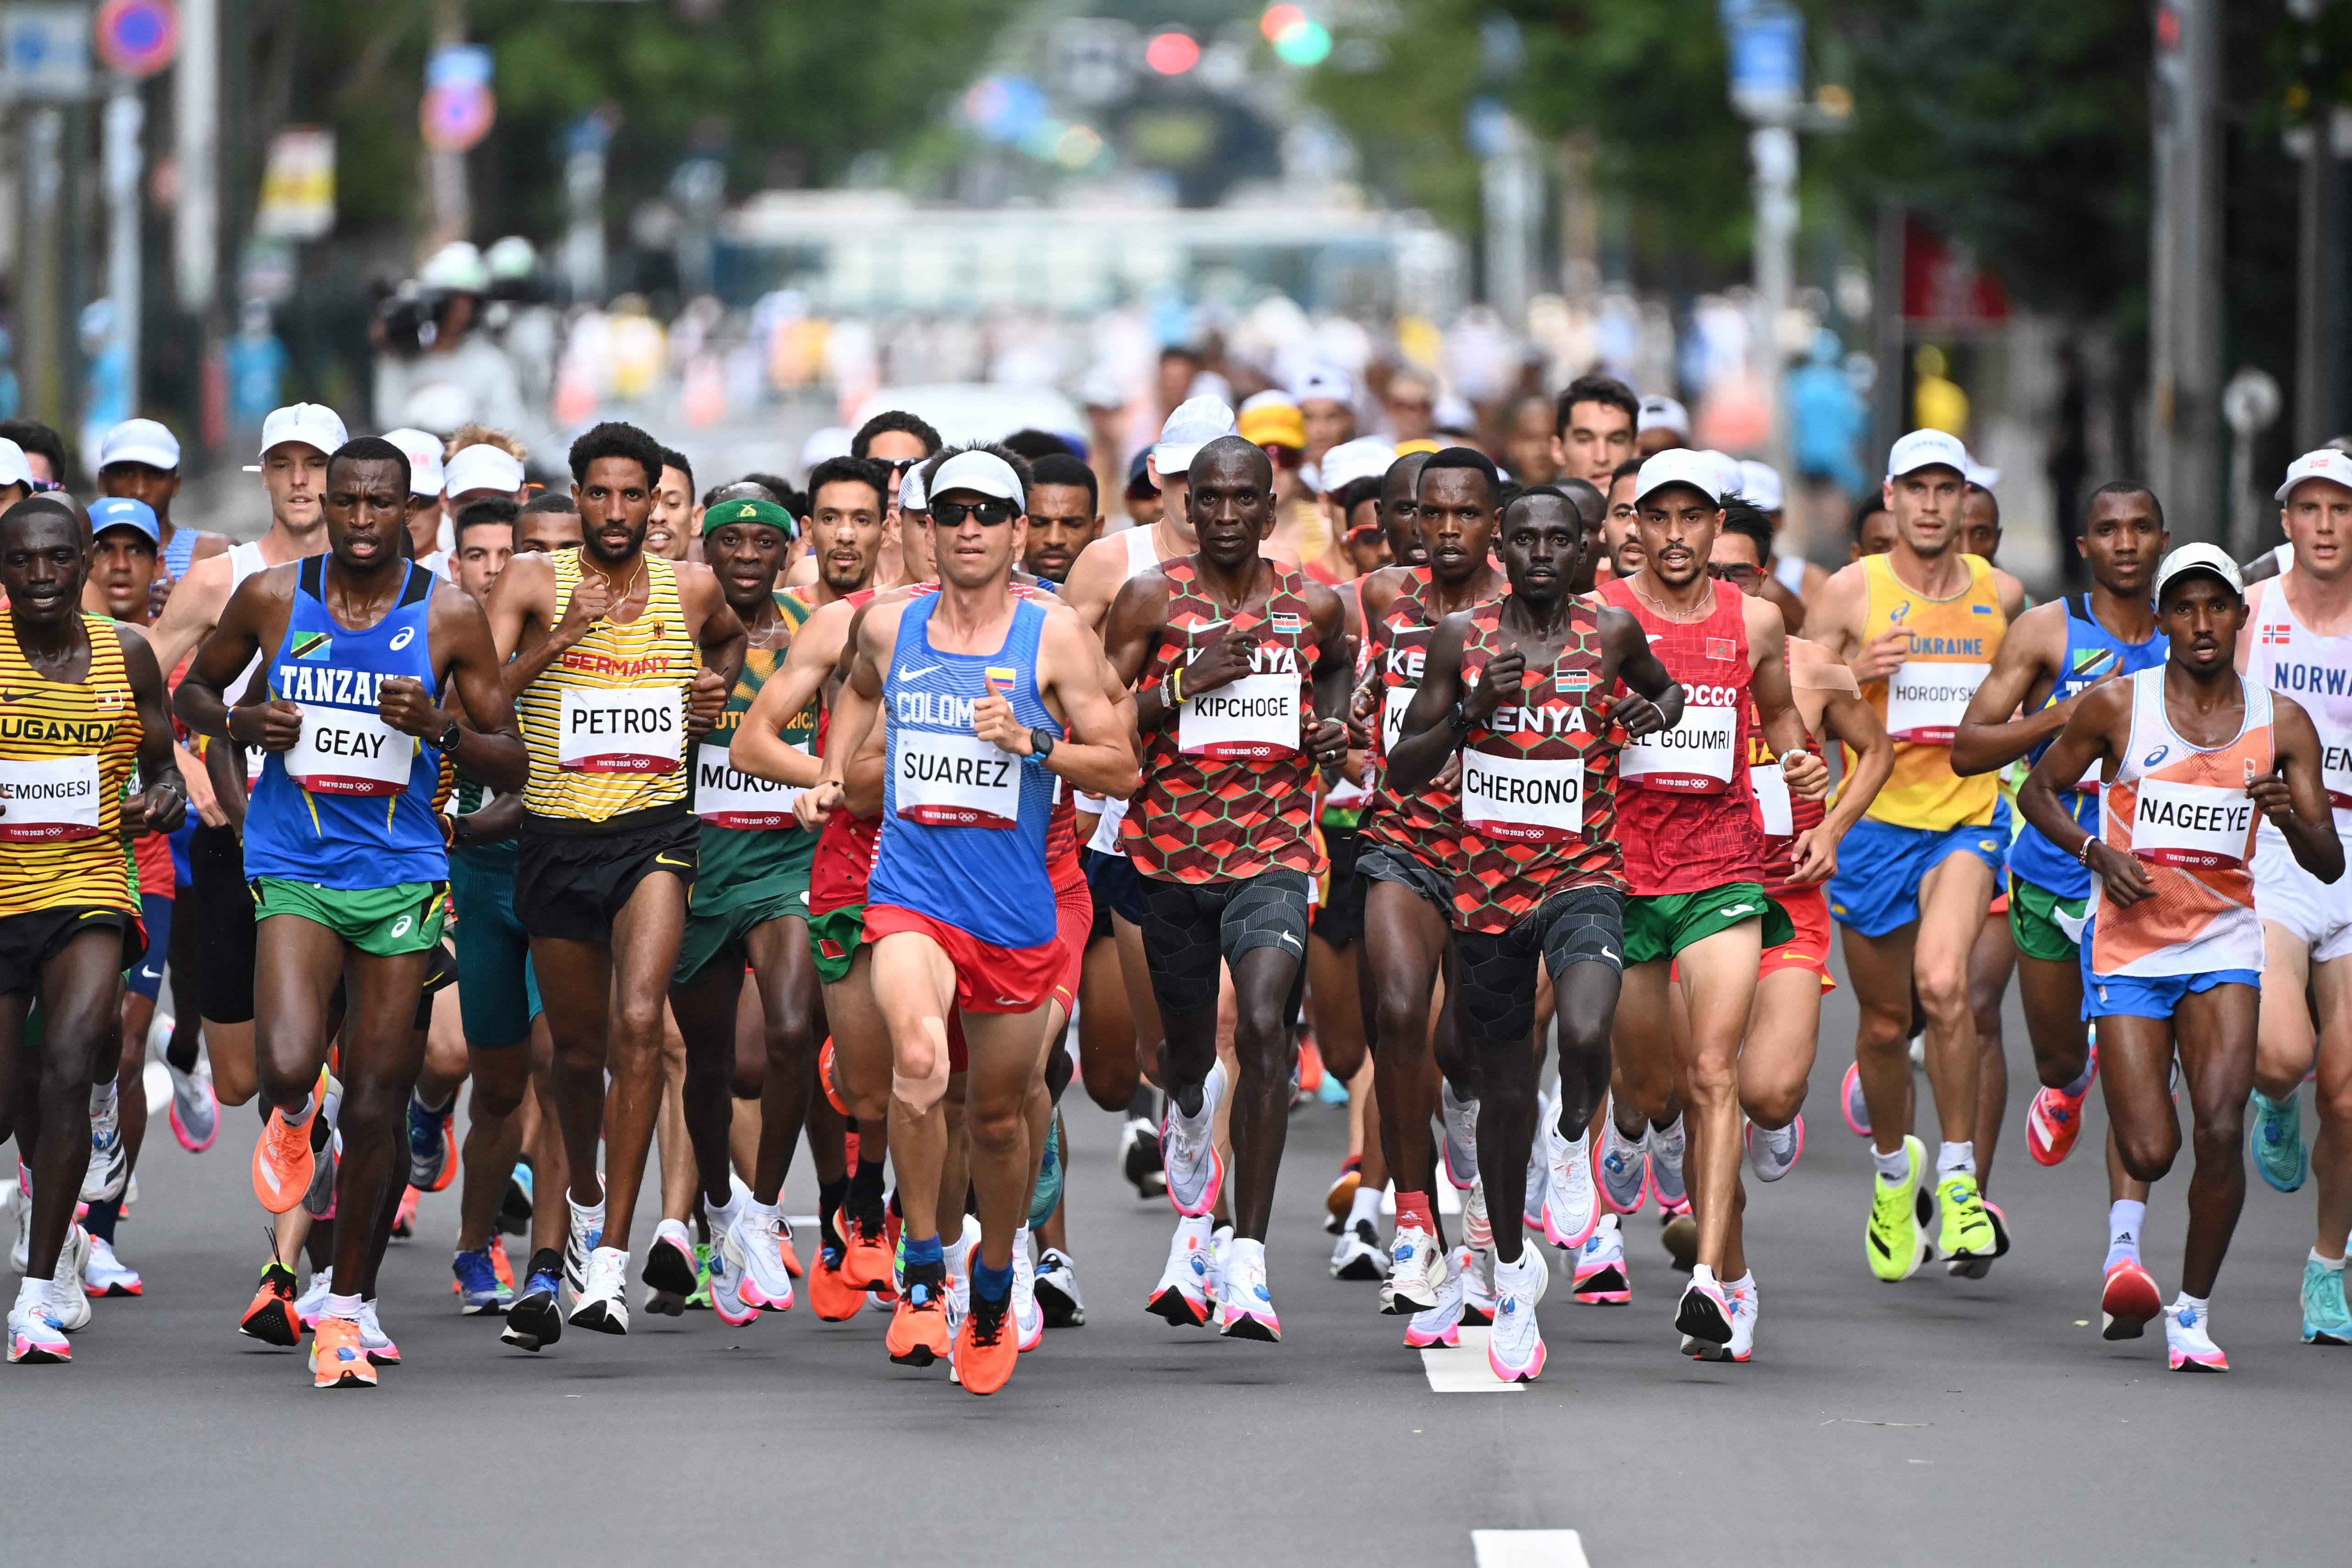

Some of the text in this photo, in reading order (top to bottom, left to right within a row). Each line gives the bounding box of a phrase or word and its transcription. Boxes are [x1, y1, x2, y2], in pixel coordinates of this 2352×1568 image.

[1910, 636, 1982, 655] UKRAINE
[562, 651, 671, 677] GERMANY
[280, 665, 421, 706] TANZA
[573, 706, 671, 734] PETROS
[897, 692, 1013, 728] COLOM
[1195, 697, 1288, 717] KIPCHOGE
[1481, 706, 1587, 733] ENYA
[1, 719, 114, 742] UGANDA
[315, 727, 387, 759] GEAY
[1661, 729, 1730, 749] GOUMRI
[904, 752, 1010, 787] SUAREZ
[1467, 768, 1578, 804] CHERONO
[922, 810, 957, 820] TOKYO 2020
[2139, 797, 2250, 831] NAGEEYE
[1492, 826, 1509, 836] TOKYO
[2166, 853, 2185, 862] TOKYO
